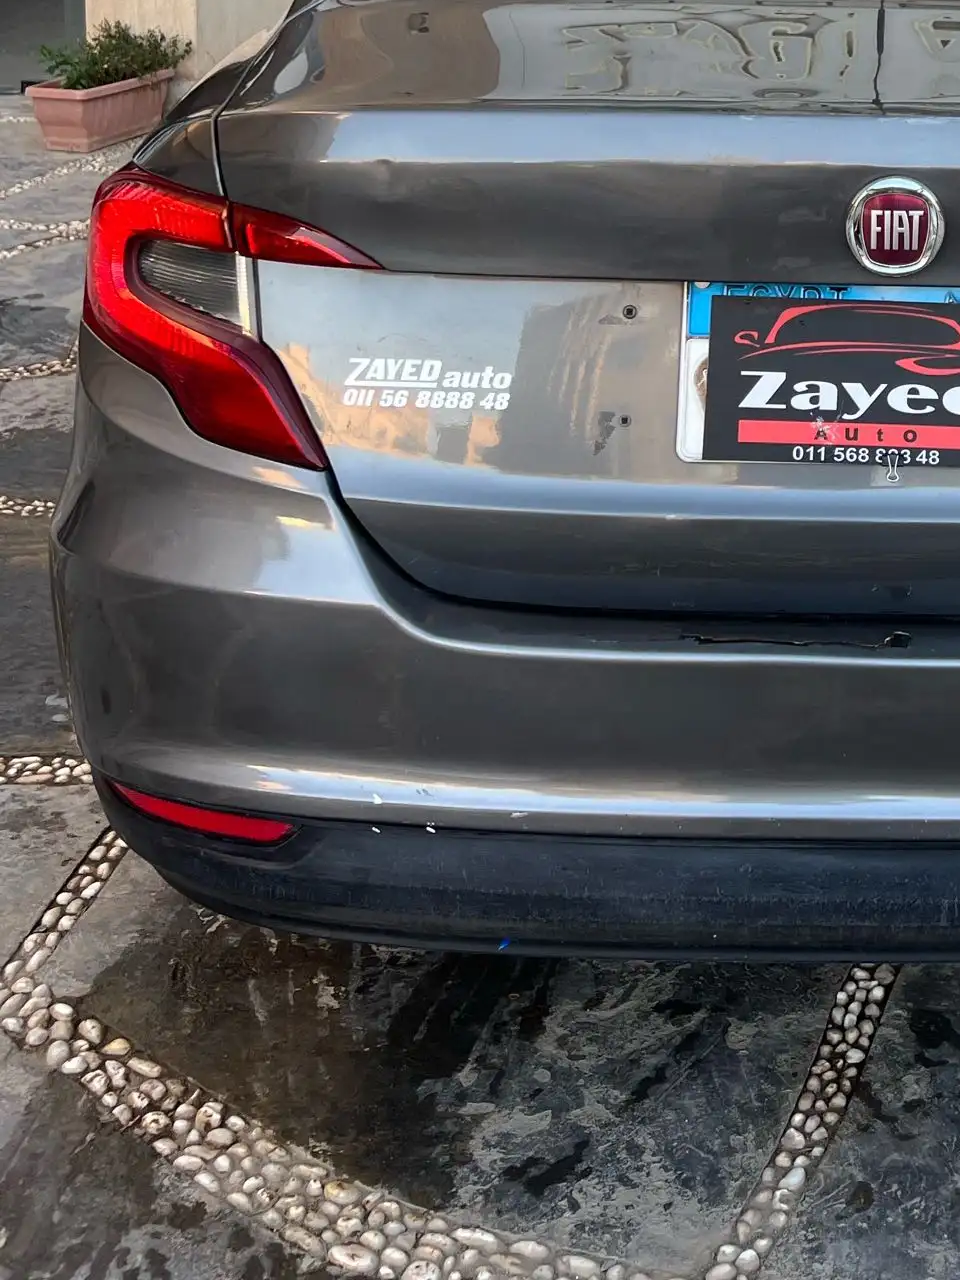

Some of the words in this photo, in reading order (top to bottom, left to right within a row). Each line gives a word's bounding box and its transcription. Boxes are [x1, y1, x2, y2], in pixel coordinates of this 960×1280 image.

[870, 209, 925, 251] FIAT
[344, 357, 443, 388] ZAYED
[442, 365, 513, 389] auto
[343, 388, 375, 407] 011
[380, 389, 410, 408] 56
[415, 390, 476, 410] 8888
[480, 392, 511, 411] 48
[814, 423, 918, 443] Auto
[792, 445, 826, 462] 011
[833, 447, 869, 463] 568
[915, 449, 940, 465] 48
